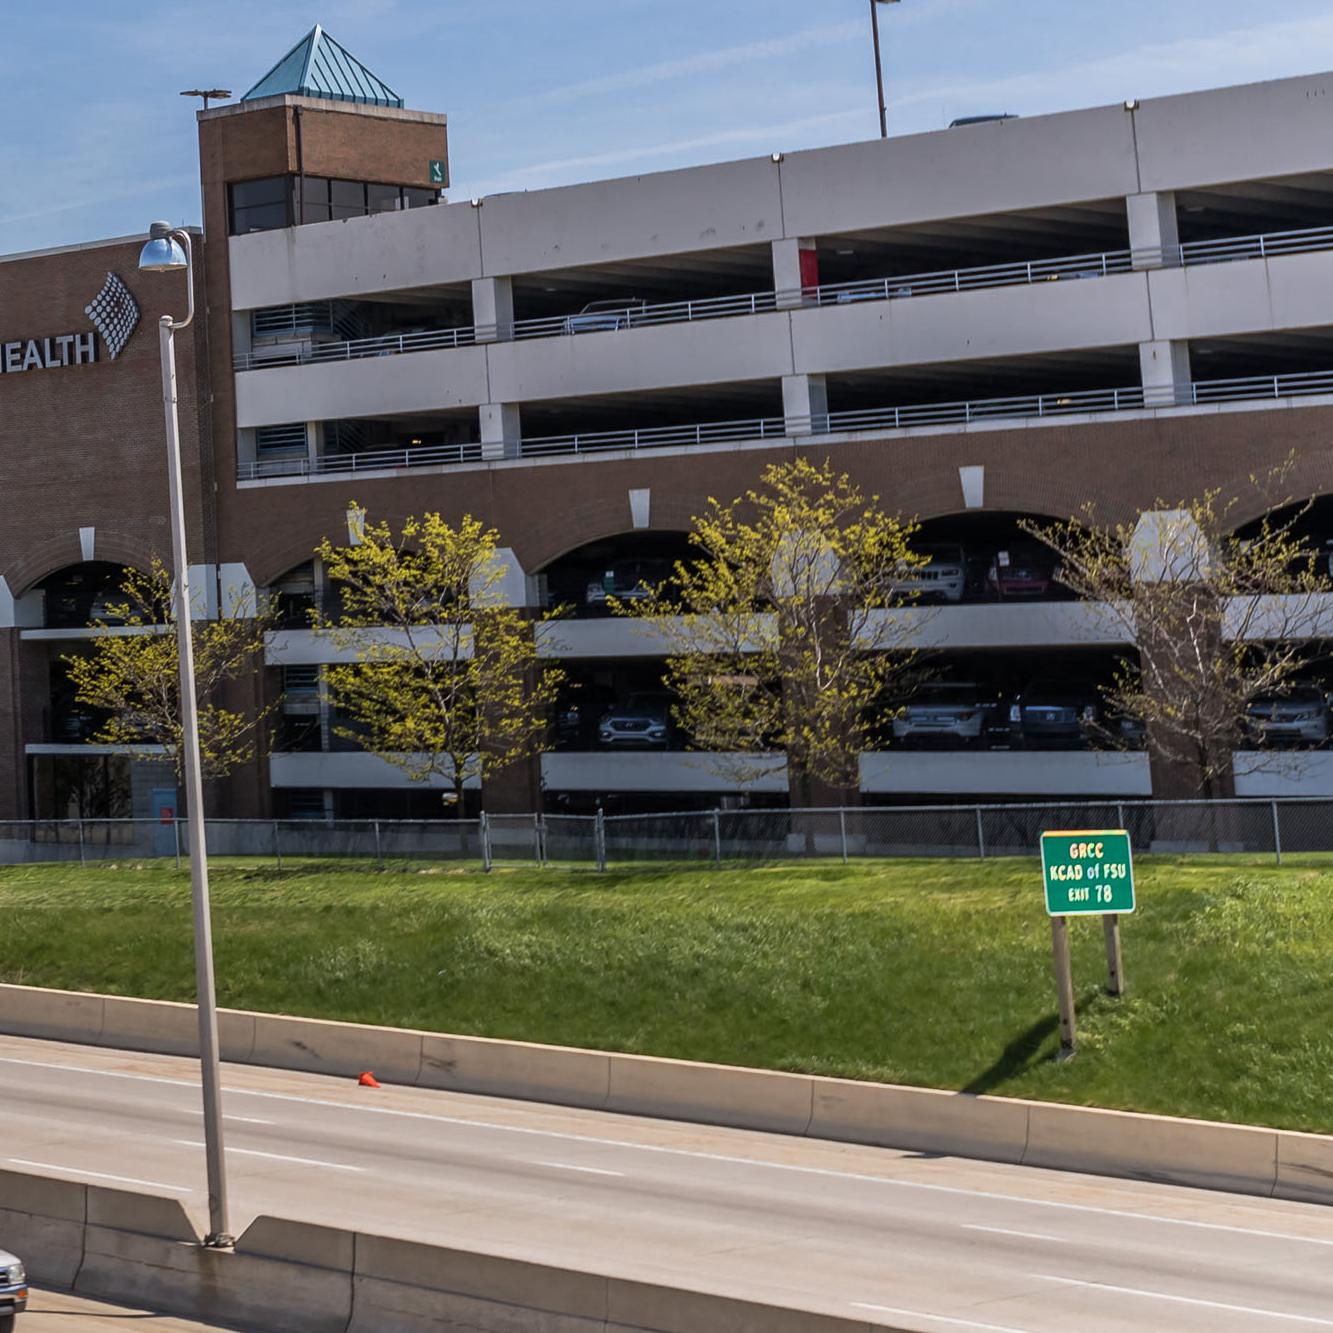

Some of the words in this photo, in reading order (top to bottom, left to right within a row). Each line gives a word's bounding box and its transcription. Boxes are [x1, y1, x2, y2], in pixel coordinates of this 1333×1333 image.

[1069, 842, 1104, 859] GRCC
[1049, 864, 1083, 881] KCAD
[1086, 863, 1100, 879] of
[1103, 863, 1126, 879] FSU
[1068, 887, 1090, 902] EXIT
[1095, 884, 1112, 903] 78
